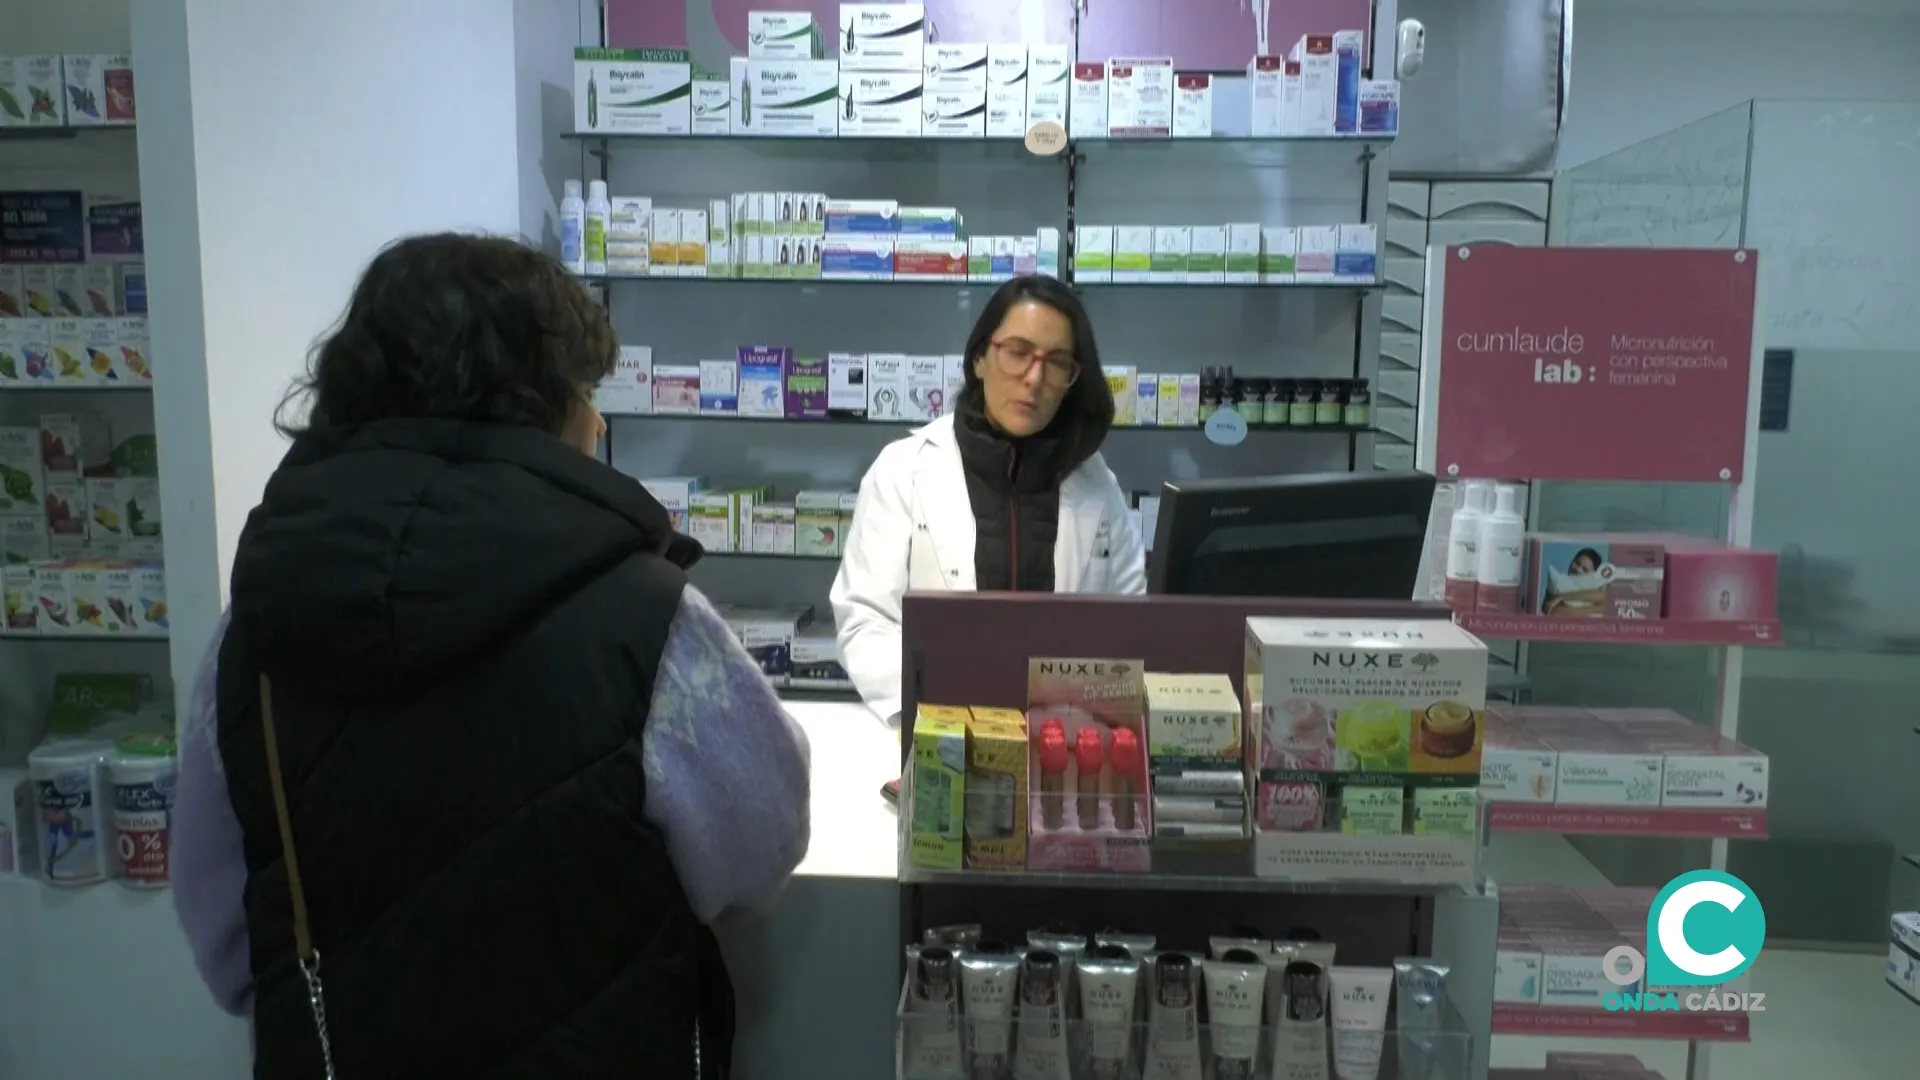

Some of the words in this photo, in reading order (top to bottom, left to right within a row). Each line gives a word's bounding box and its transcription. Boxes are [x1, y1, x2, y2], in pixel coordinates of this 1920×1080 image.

[1457, 326, 1584, 354] cumlaude
[1610, 334, 1714, 351] Micronutrición
[1609, 355, 1638, 367] con
[1642, 355, 1728, 369] perspectiva
[1608, 370, 1676, 385] femenina
[1313, 651, 1404, 668] NUXE
[1041, 663, 1105, 674] NUXE
[1163, 715, 1209, 725] NUXE
